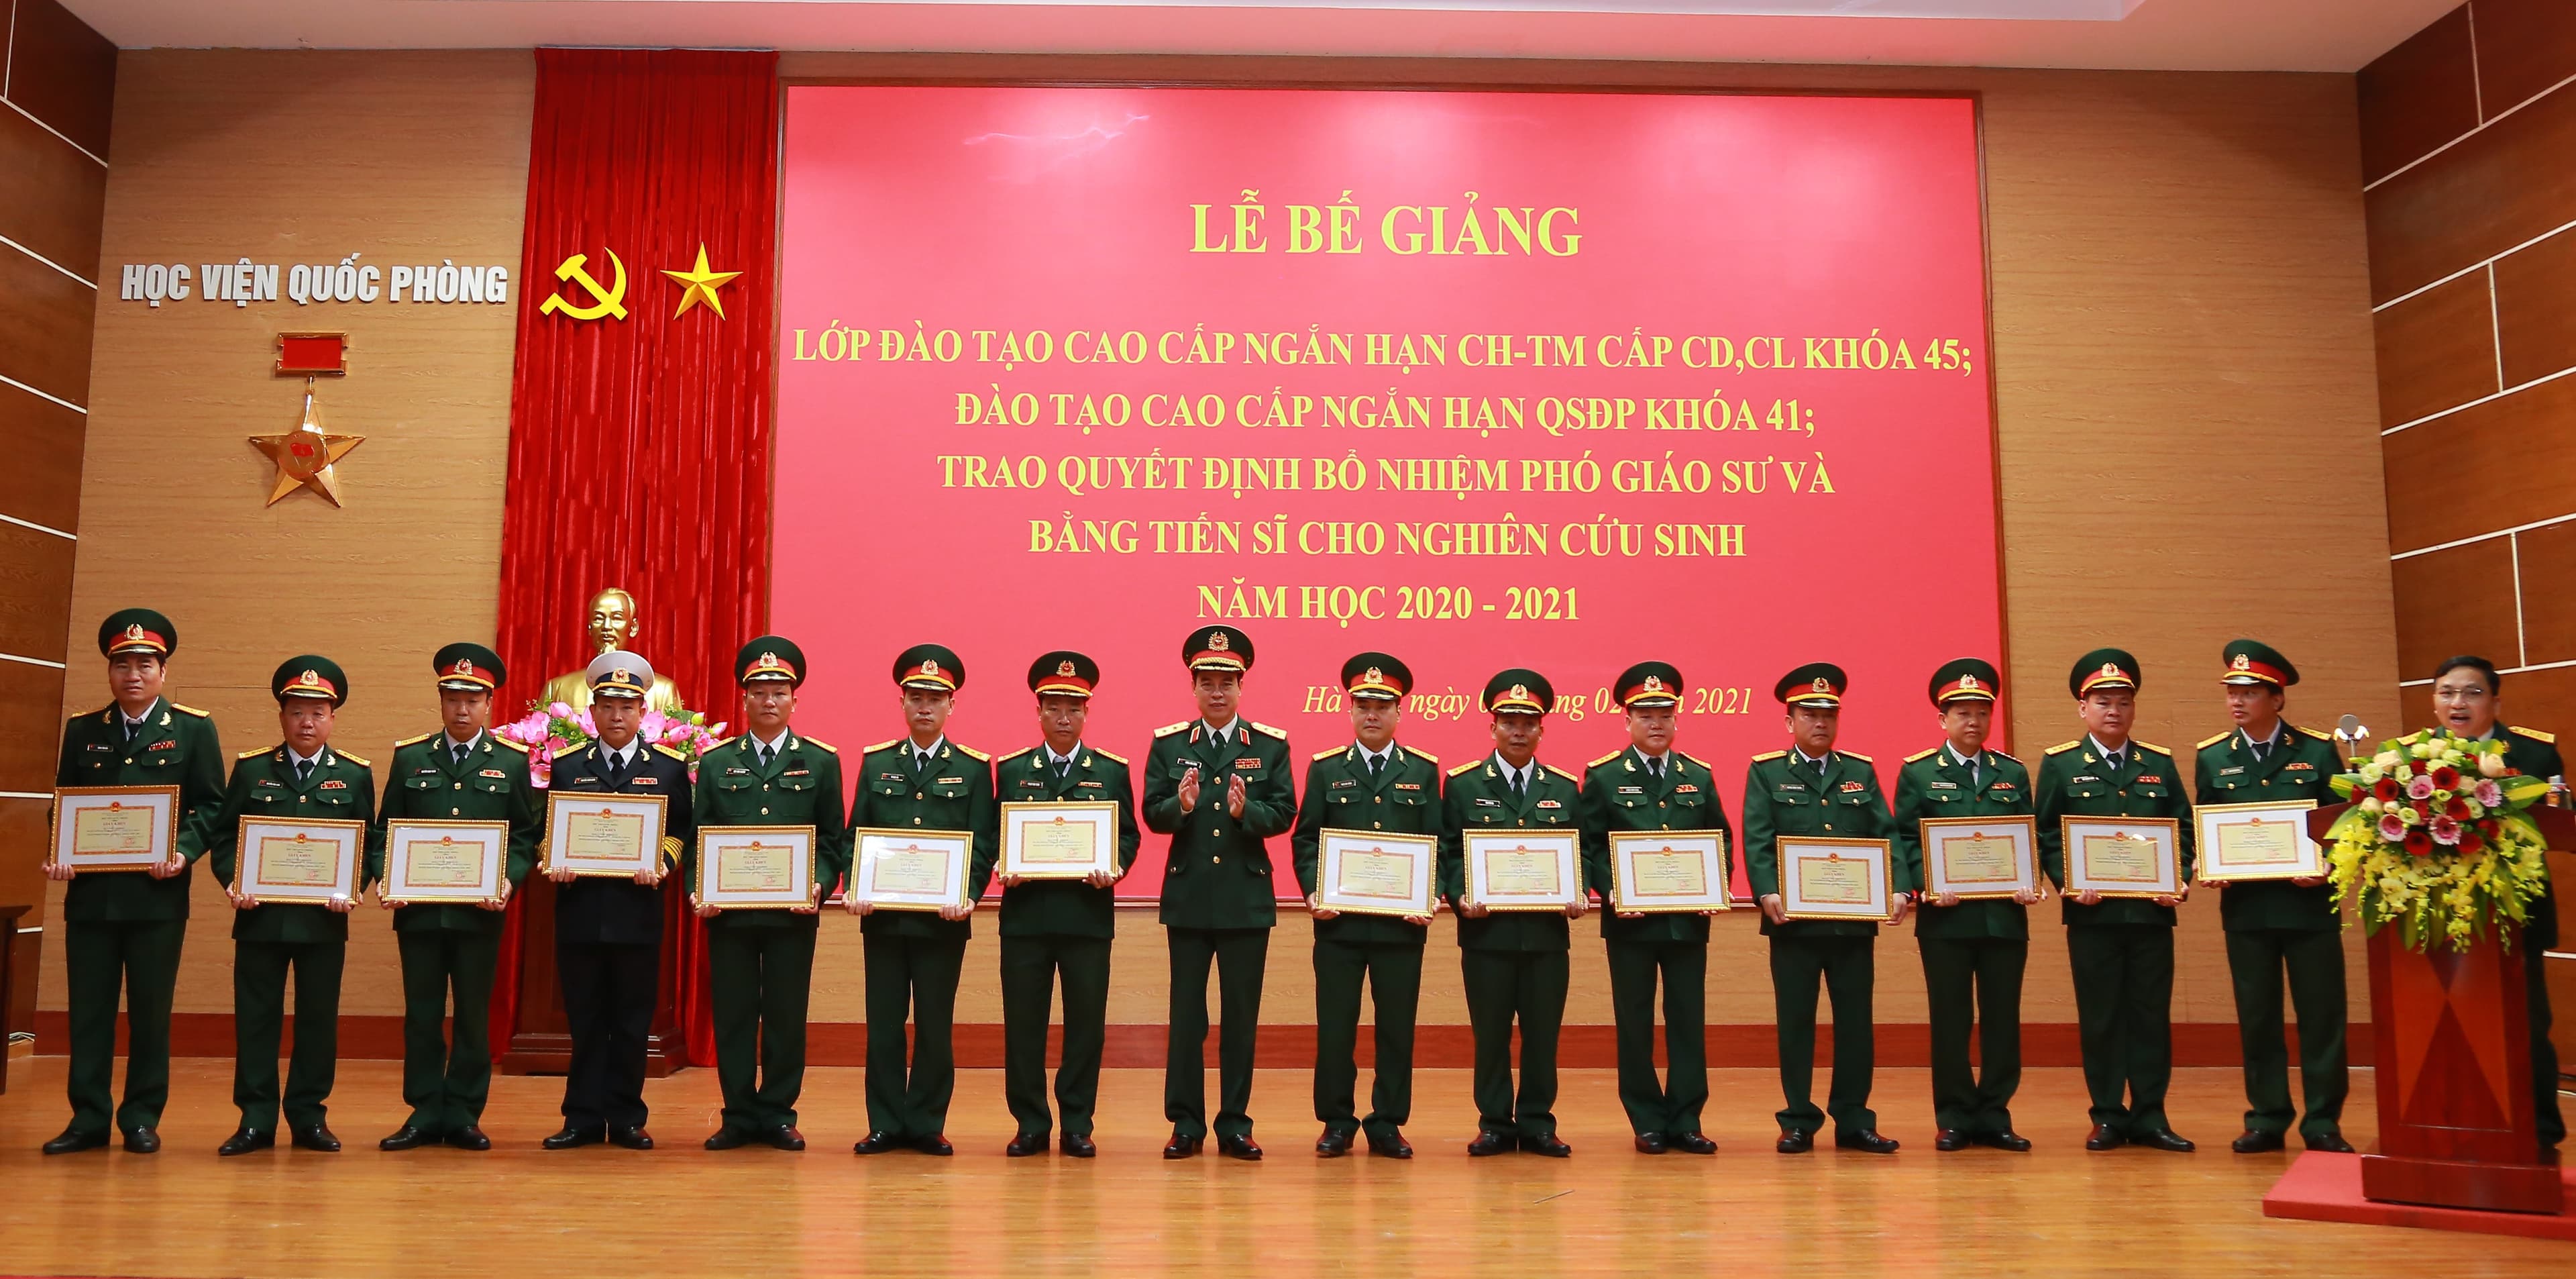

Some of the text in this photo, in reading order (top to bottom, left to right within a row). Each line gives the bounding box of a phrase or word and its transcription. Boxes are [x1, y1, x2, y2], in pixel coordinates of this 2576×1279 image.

[1191, 189, 1582, 256] LỄ BẾ GIẢNG
[121, 253, 508, 307] HỌC VIỆN QUỐC PHÒNG
[794, 319, 1972, 376] LỚP ĐÀO TẠO CAO CẤP NGẮN HẠN CH-TM CẤP CD,CL KHÓA 45;
[957, 383, 1815, 438] ĐÀO TẠO CAO CẤP NGẮN HẠN QSĐP KHÓA 41;
[936, 448, 1835, 501] TRAO QUYẾT ĐỊNH BỔ NHIỆM PHÓ GIÁO SƯ VÀ
[1030, 511, 1745, 557] BẰNG TIẾN SĨ CHO NGHIÊN CỨU SINH
[1198, 578, 1287, 619] NĂM
[1300, 585, 1385, 628] HỌC
[1396, 586, 1472, 619] 2020
[1505, 586, 1578, 620] 2021
[1302, 686, 1342, 713] Hà
[1409, 686, 1470, 721] ngày
[1692, 687, 1752, 714] 2021
